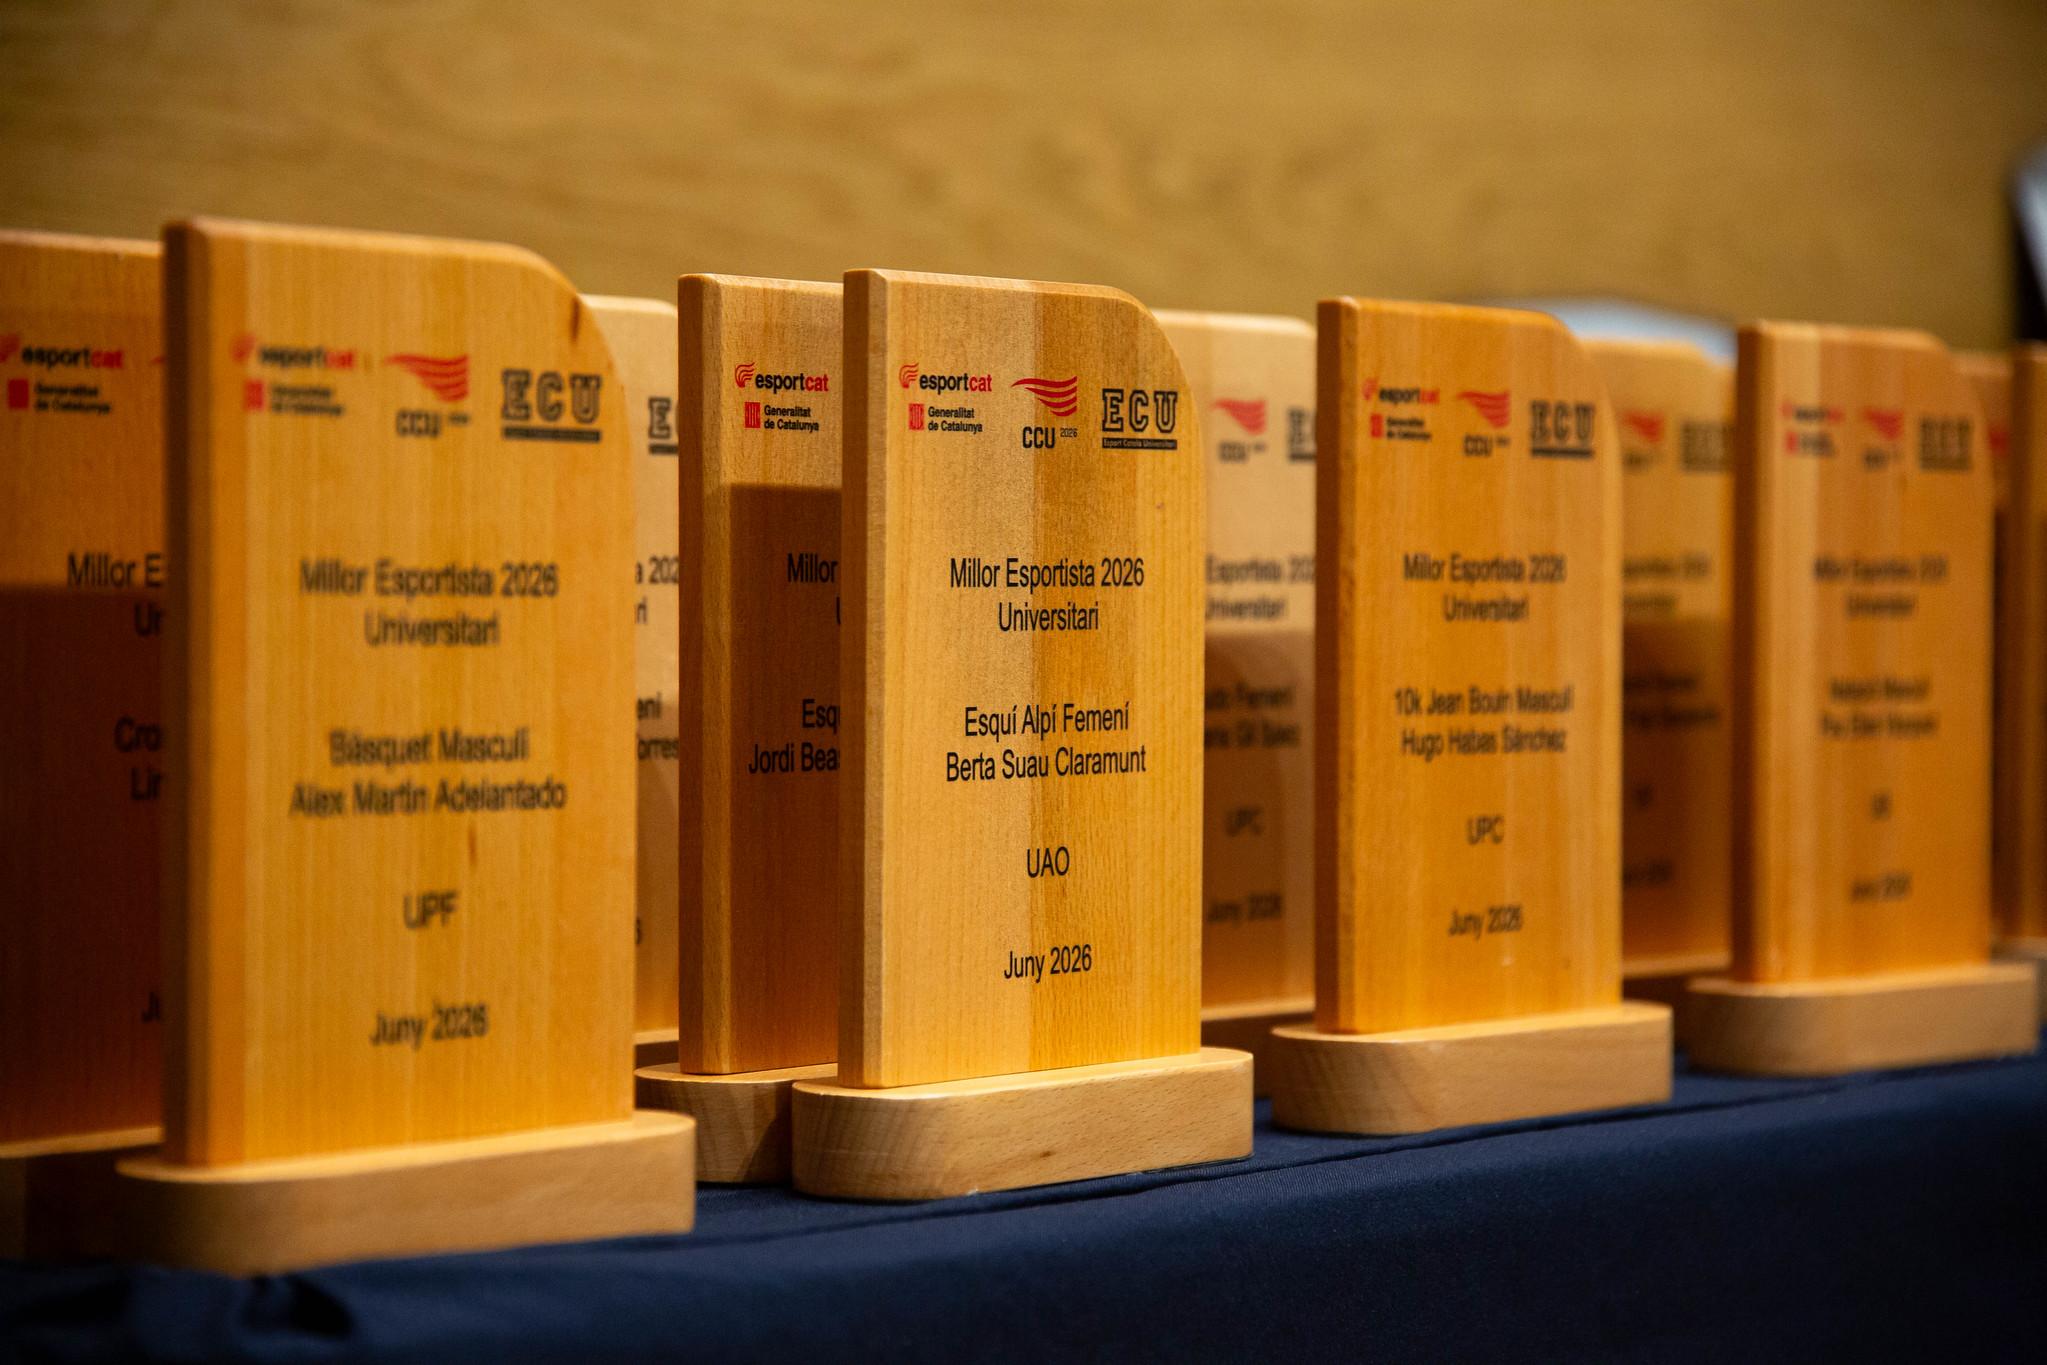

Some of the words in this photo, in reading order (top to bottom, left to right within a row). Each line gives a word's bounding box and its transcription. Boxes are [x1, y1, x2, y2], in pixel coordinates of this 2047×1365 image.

[501, 368, 602, 424] ECU
[755, 372, 830, 395] esportcat
[919, 373, 993, 395] esportcat
[764, 404, 812, 418] Generalitat
[764, 419, 775, 430] de
[777, 419, 820, 434] Catalunya
[928, 406, 975, 419] Generalitat
[1102, 388, 1178, 433] ECU
[1531, 400, 1594, 441] ECU
[928, 420, 939, 431] de
[941, 420, 983, 435] Catalunya
[1022, 426, 1056, 449] CCU
[1060, 427, 1078, 438] 2026
[68, 552, 135, 589] Millor
[301, 558, 367, 597] Millor
[374, 557, 495, 603] Esportista
[501, 560, 559, 598] 2026
[649, 556, 679, 585] 202
[786, 552, 838, 583] Millor
[950, 557, 1000, 588] Millor
[1006, 557, 1095, 595] Esportista
[1101, 556, 1145, 587] 2026
[1403, 553, 1445, 582] Millor
[363, 608, 499, 648] Universitari
[998, 601, 1099, 632] Universitari
[965, 705, 1017, 742] Esquí
[1021, 703, 1057, 741] Alpí
[1063, 701, 1129, 732] Femení
[637, 737, 679, 761] orres
[748, 742, 795, 774] Jordi
[1401, 728, 1444, 763] Hugo
[947, 751, 995, 782] Berta
[1002, 748, 1049, 779] Suau
[1055, 744, 1147, 776] Claramunt
[434, 773, 568, 813] Adelantado
[1027, 846, 1070, 878] UAO
[403, 888, 459, 931] UPF
[1004, 950, 1045, 983] Juny
[1050, 944, 1092, 974] 2026
[369, 1010, 427, 1052] Juny
[432, 1002, 488, 1041] 2026
